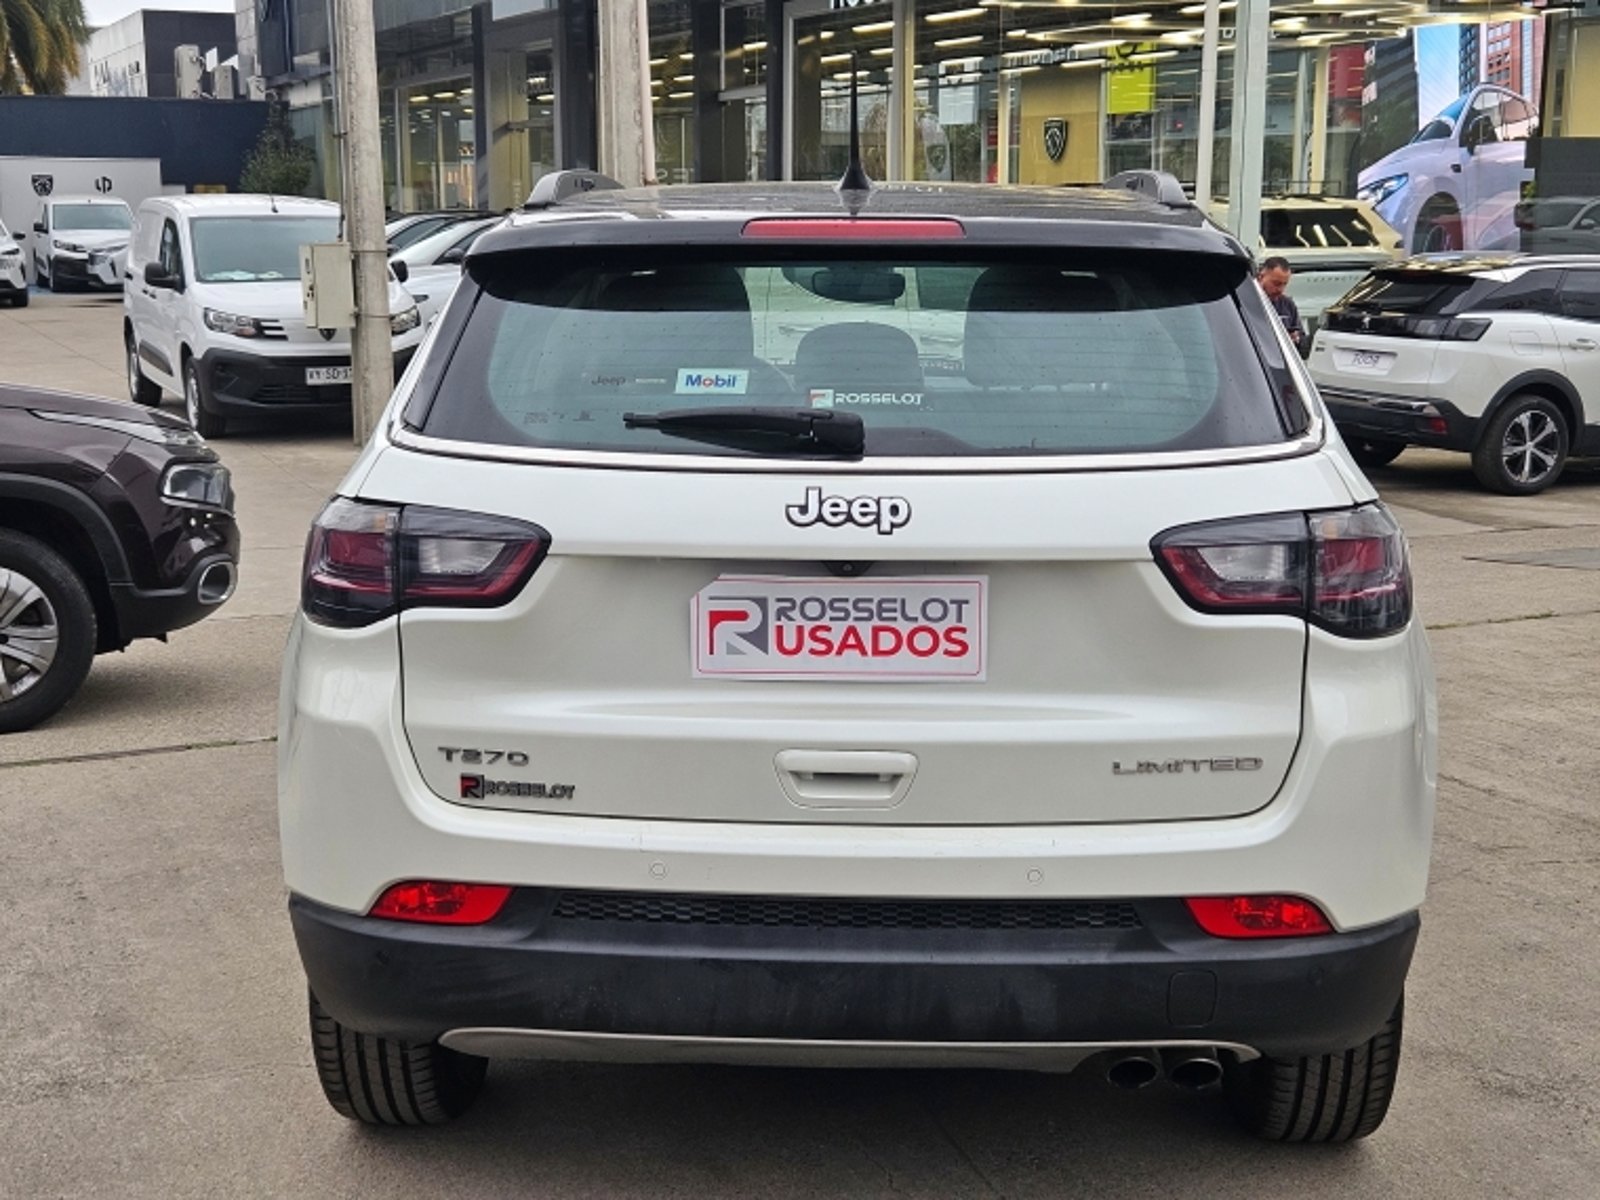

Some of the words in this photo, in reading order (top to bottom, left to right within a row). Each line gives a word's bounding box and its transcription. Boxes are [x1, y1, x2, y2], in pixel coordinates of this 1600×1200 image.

[685, 373, 736, 388] Mobil
[835, 392, 924, 406] ROSSELOT
[785, 486, 912, 536] Jeep
[774, 596, 971, 624] ROSSELOT
[775, 624, 970, 658] USADOS
[1112, 757, 1265, 776] LIMITED
